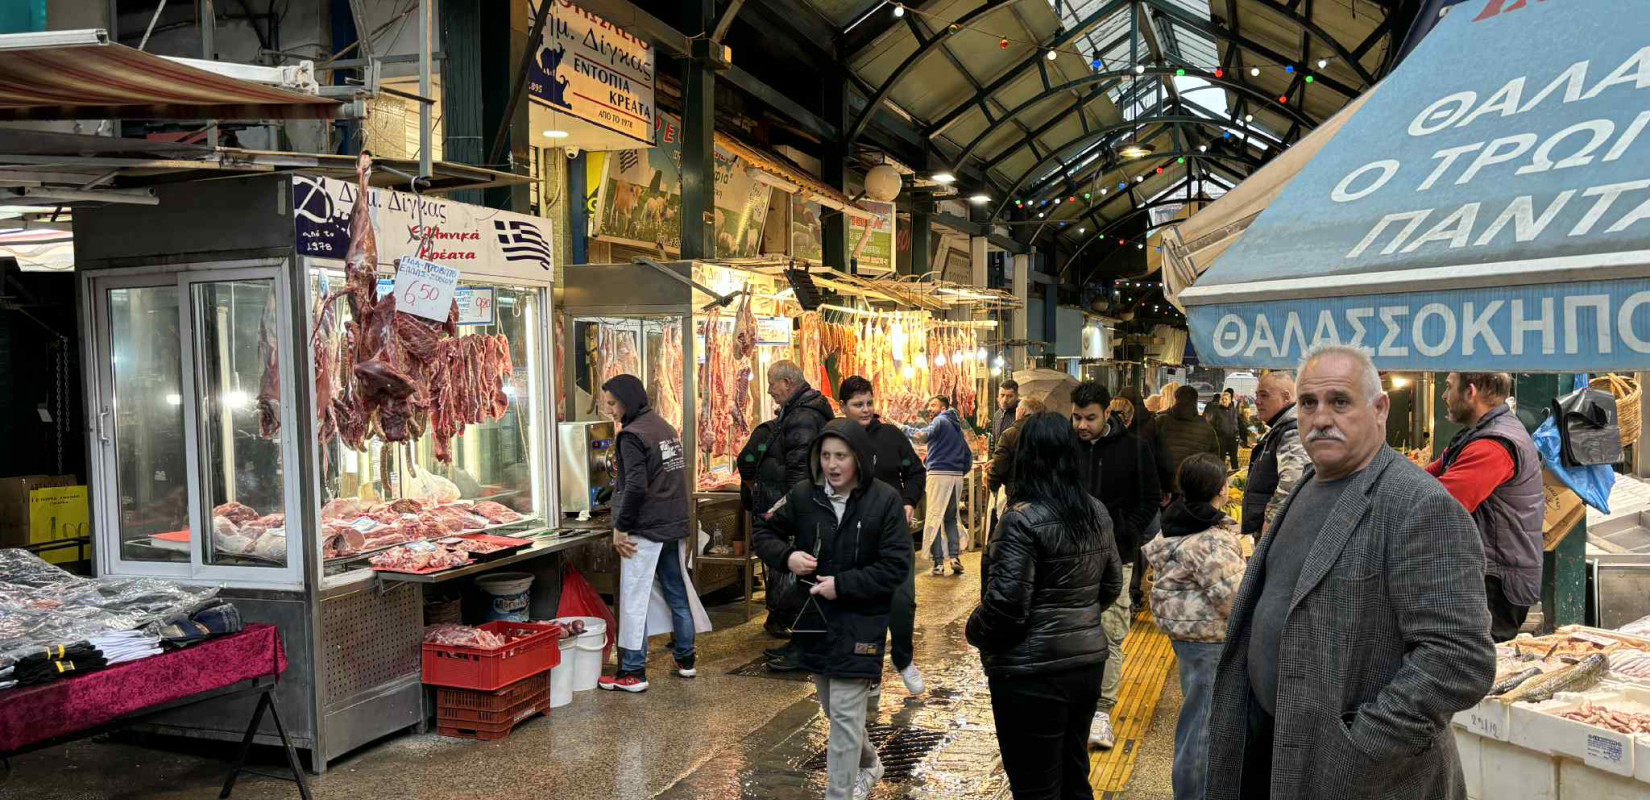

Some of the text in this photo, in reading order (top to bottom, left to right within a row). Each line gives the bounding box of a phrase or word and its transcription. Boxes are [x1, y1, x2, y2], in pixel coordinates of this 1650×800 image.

[582, 28, 651, 82] Δίγκας
[573, 57, 630, 94] ΕΝΤΟΠΙΑ
[598, 110, 633, 128] ΑΠΟ ΤΟ 1978
[609, 91, 651, 119] ΚΡΕΑΤΑ
[1331, 159, 1400, 202] Ο
[306, 241, 333, 251] 1978
[419, 246, 476, 262] Κρέατα
